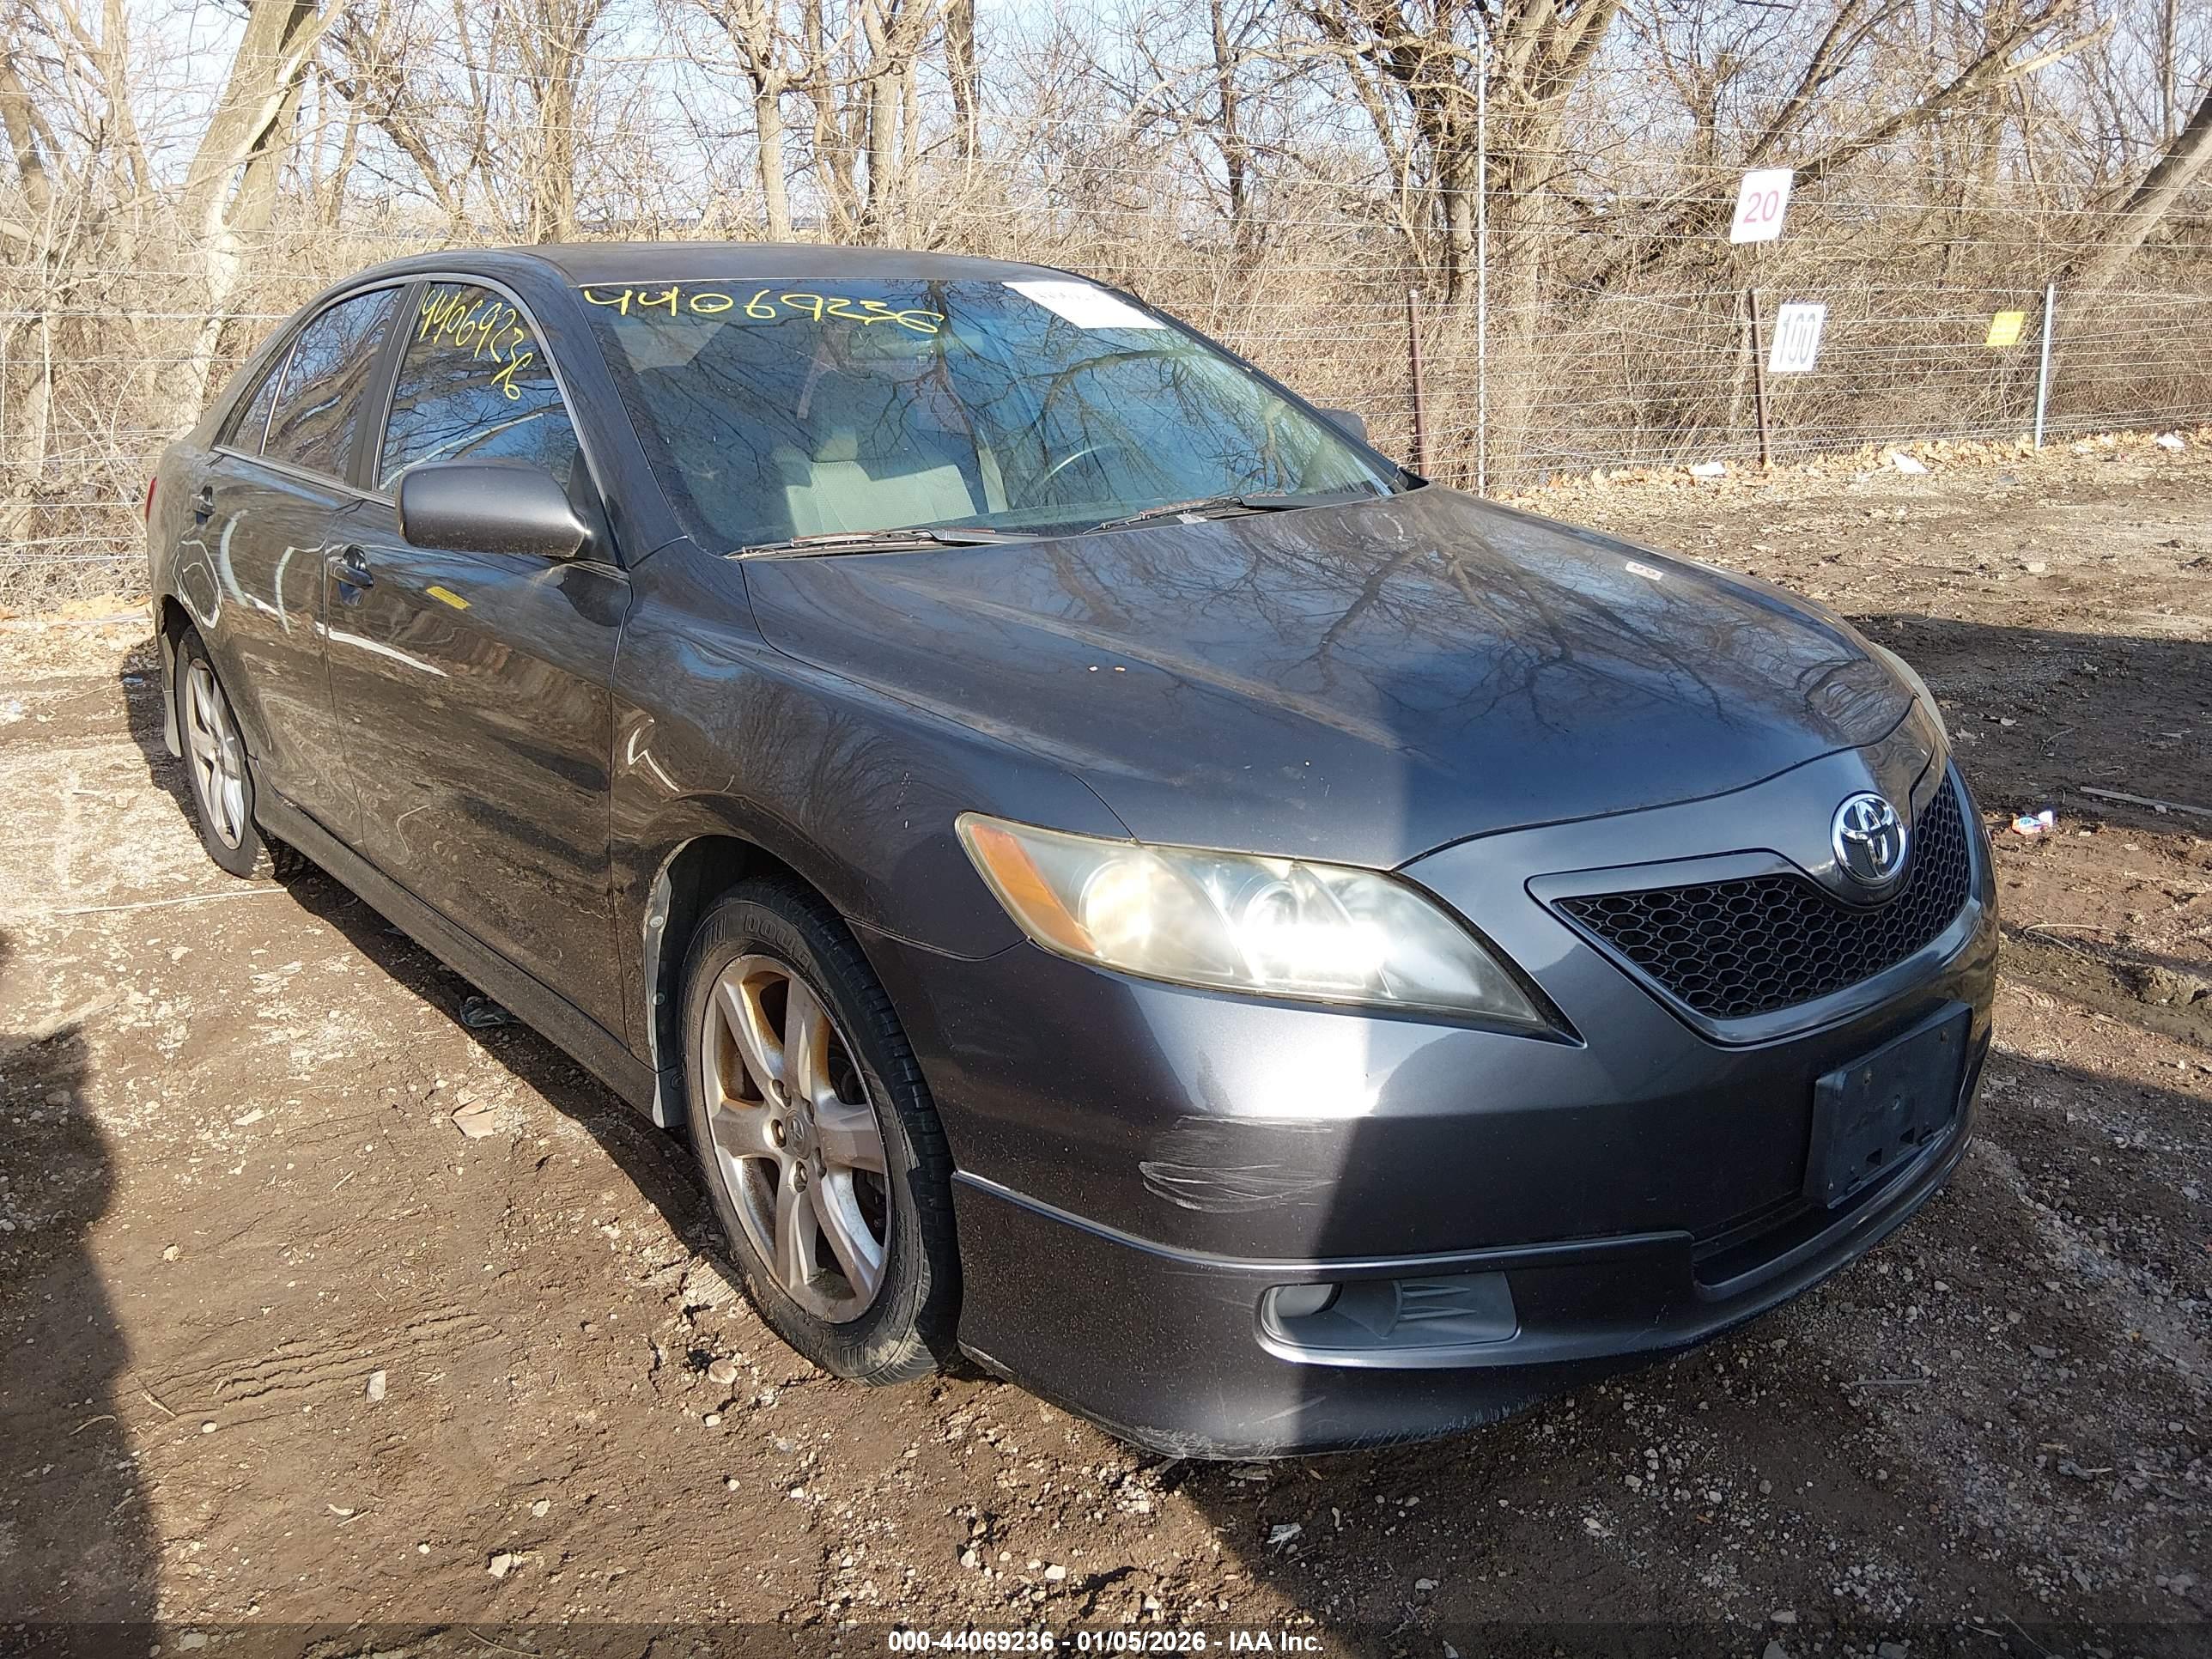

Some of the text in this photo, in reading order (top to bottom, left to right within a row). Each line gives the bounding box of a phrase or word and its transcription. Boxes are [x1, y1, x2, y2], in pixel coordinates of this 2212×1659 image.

[1743, 190, 1779, 224] 20
[584, 286, 945, 333] 44069236
[418, 289, 533, 400] 44069236
[1779, 313, 1816, 365] 100
